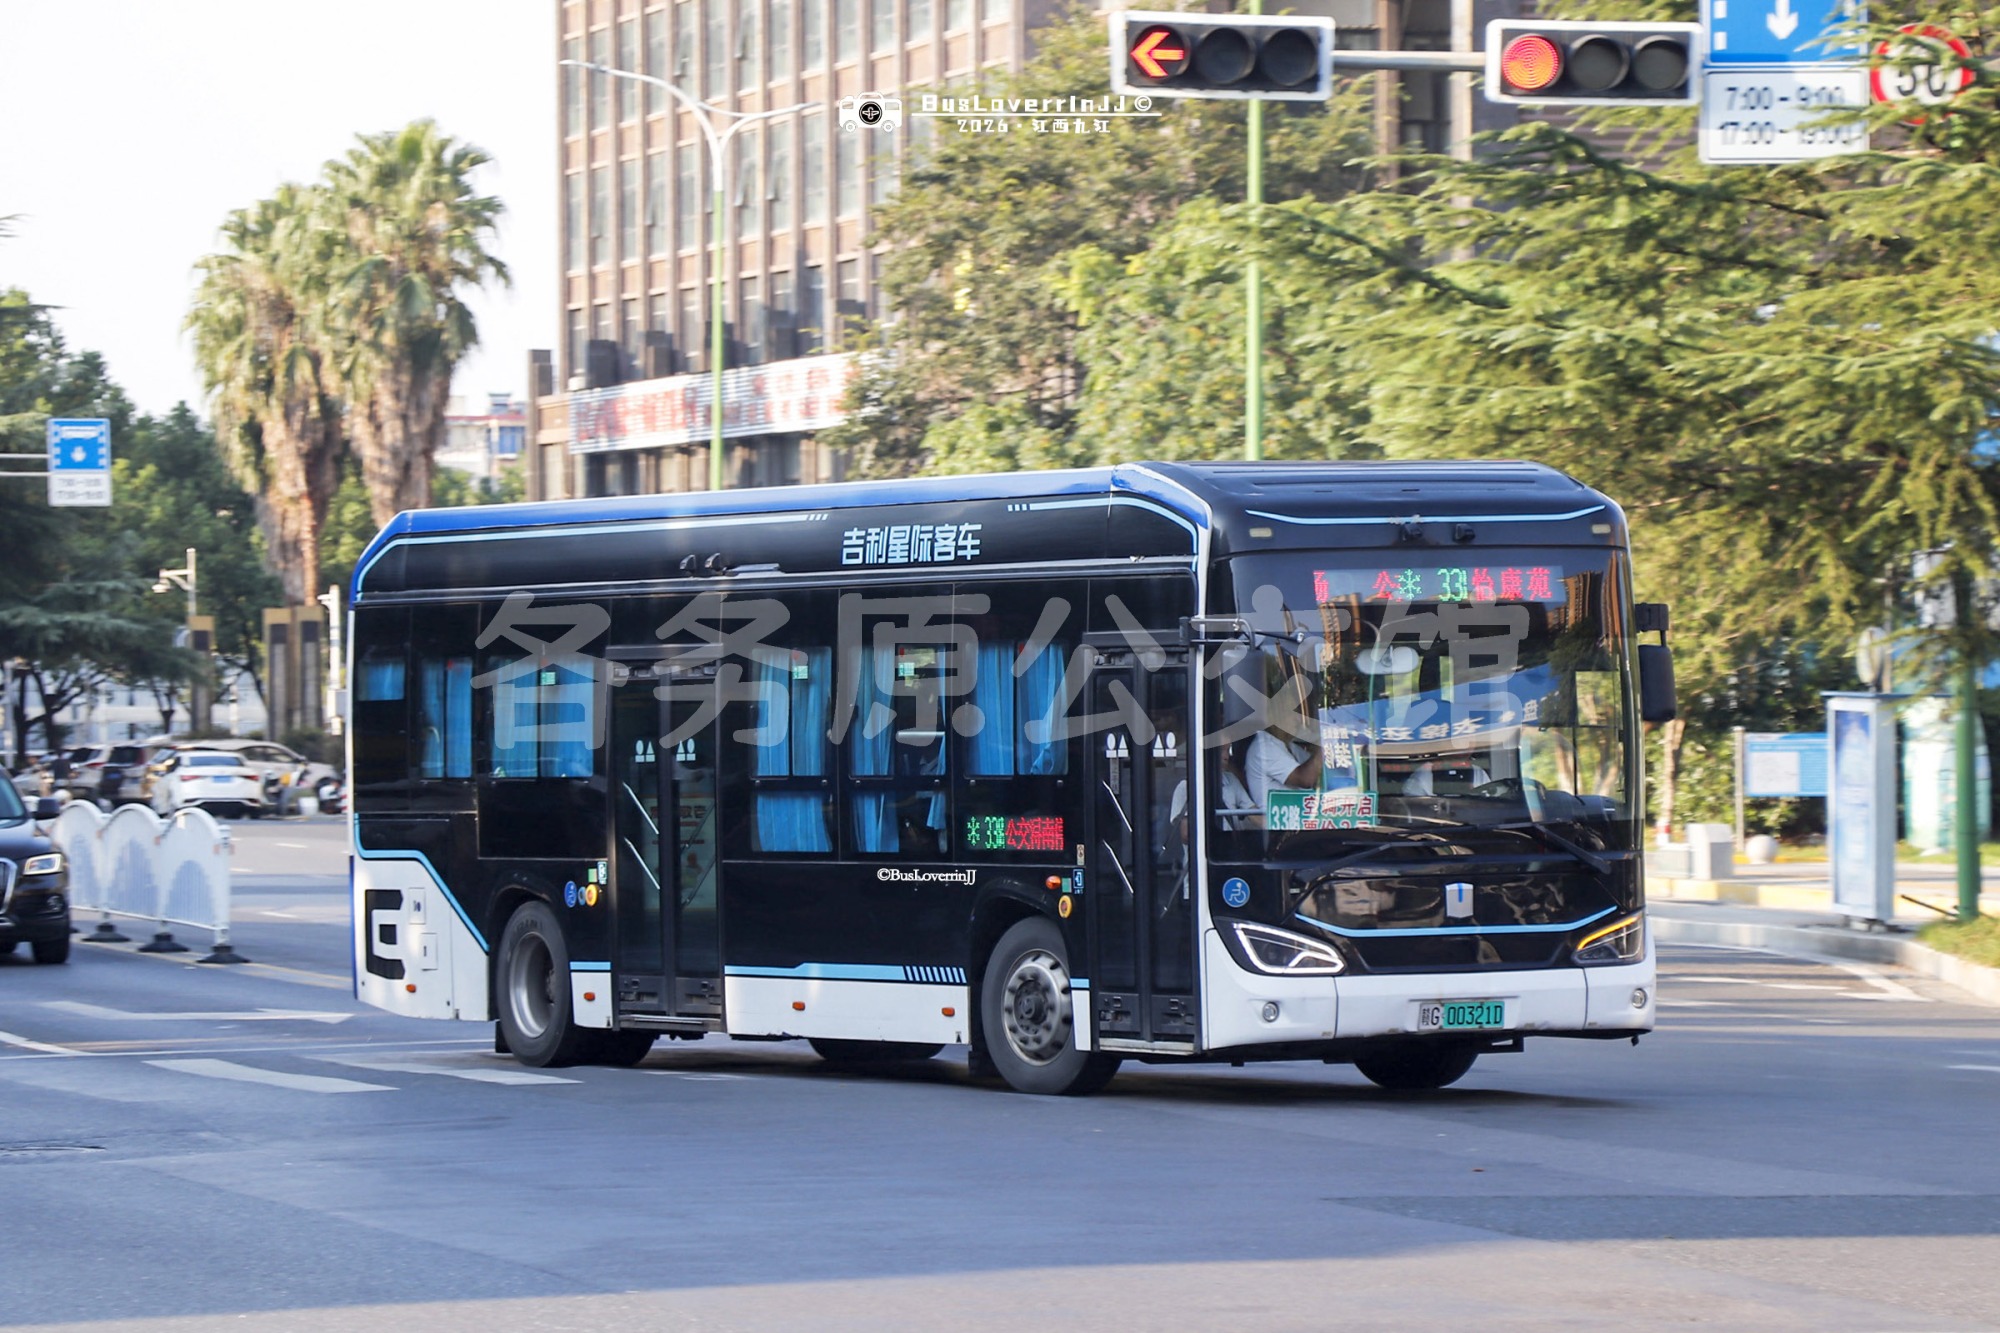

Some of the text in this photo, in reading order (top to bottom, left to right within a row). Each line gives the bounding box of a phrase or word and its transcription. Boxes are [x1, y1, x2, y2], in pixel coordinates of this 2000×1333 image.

[1725, 86, 1773, 110] 7:00
[1797, 86, 1846, 109] 9:00
[1719, 121, 1774, 145] 17:00
[842, 523, 982, 564] 吉利星际客车
[1471, 567, 1553, 601] 怡康苑
[1303, 796, 1373, 816] 空调开启
